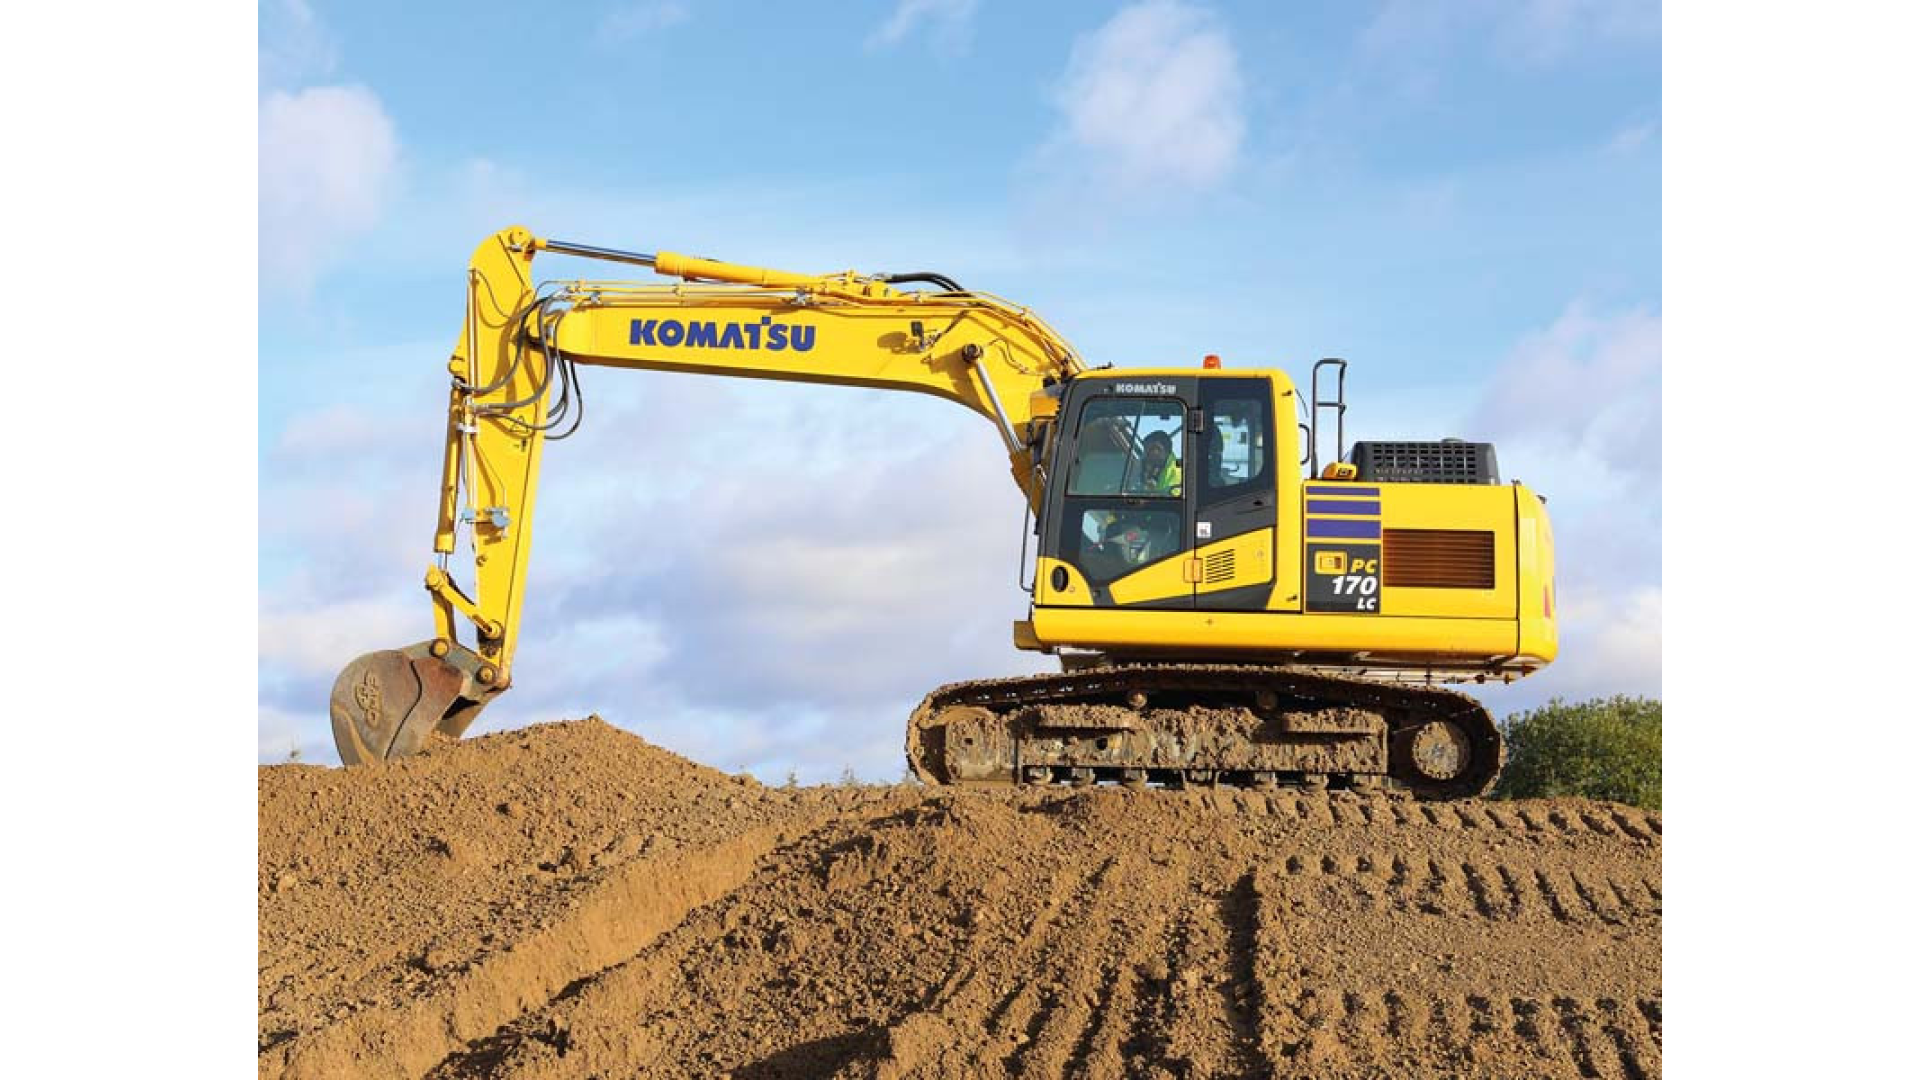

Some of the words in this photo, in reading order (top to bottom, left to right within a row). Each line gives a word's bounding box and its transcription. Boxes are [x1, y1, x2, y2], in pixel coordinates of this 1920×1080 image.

[629, 316, 816, 352] KOMATSU
[1116, 382, 1177, 395] KOMATSU
[1350, 559, 1377, 574] PC
[1332, 575, 1377, 595] 170
[1357, 597, 1377, 610] LC
